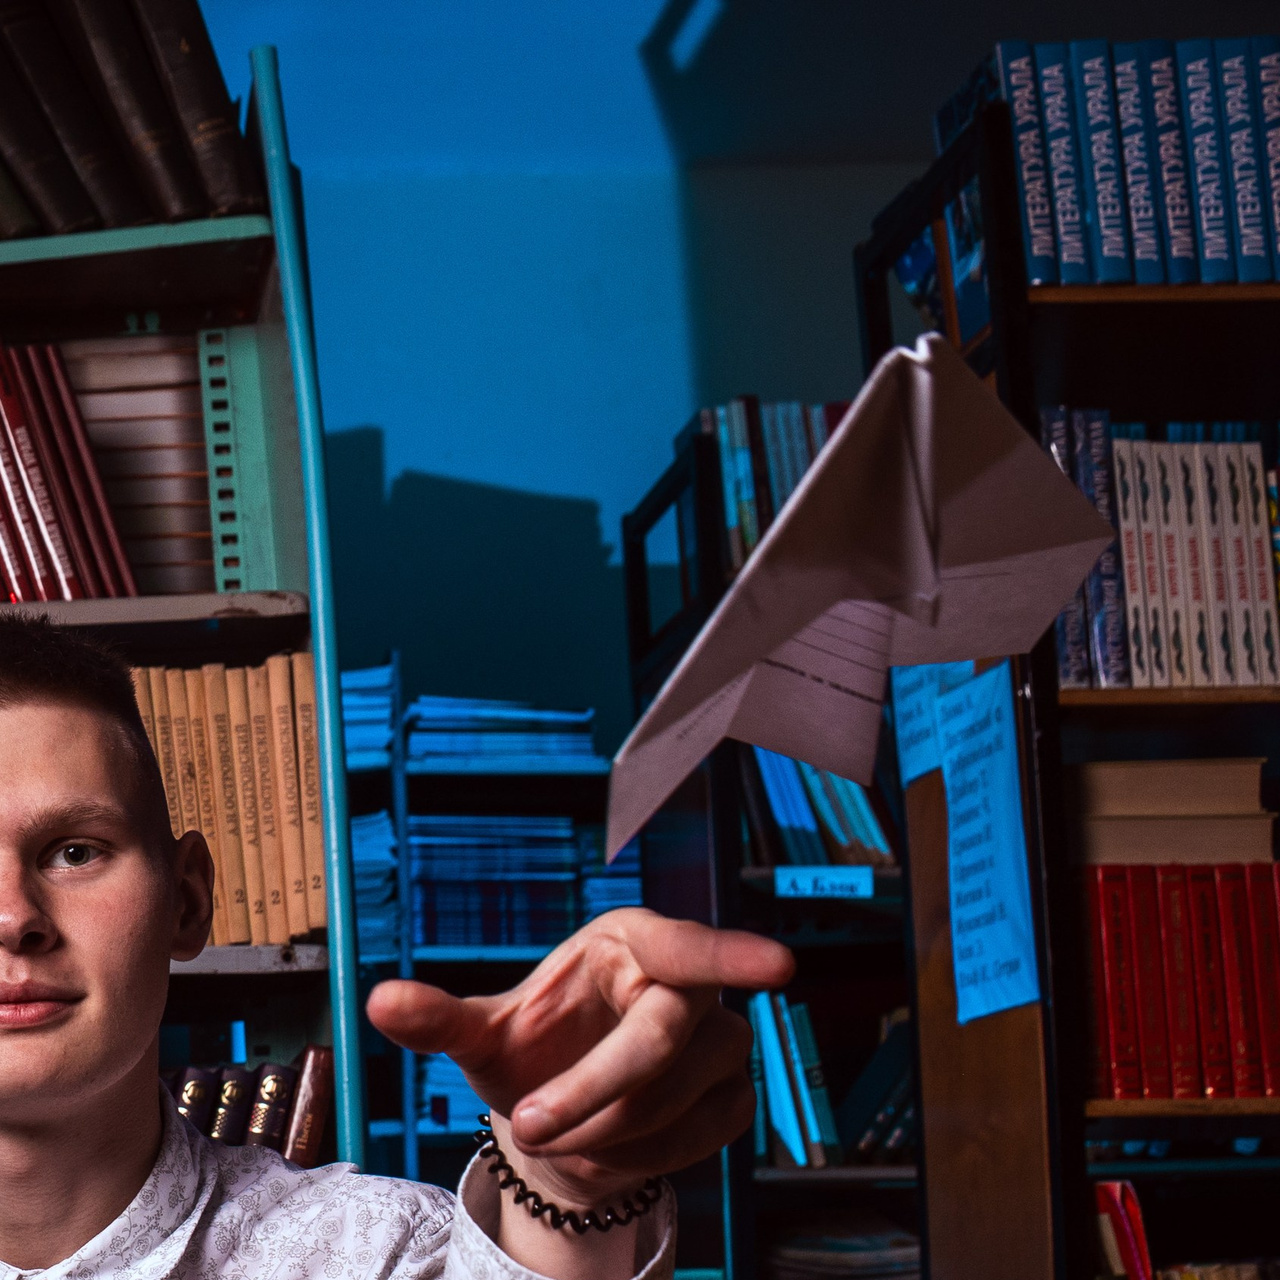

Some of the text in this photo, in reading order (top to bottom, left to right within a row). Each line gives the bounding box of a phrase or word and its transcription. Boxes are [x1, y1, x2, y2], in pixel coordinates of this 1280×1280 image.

[1009, 56, 1054, 258] ЛИТЕРАТУРА УРАЛА
[1042, 63, 1085, 264] ЛИТЕРАТУРА УРАЛА
[1083, 56, 1125, 259] ЛИТЕРАТУРА УРАЛА
[1116, 60, 1158, 262] ЛИТЕРАТУРА УРАЛА
[1150, 56, 1194, 260] ЛИТЕРАТУРА УРАЛА
[1186, 57, 1228, 260] ЛИТЕРАТУРА УРАЛА
[1222, 56, 1265, 257] ЛИТЕРАТУРА УРАЛА
[15, 427, 36, 466] УРАЛА
[27, 467, 56, 523] ИСТОРИЯ
[177, 717, 195, 813] ОСТРОВСКИЙ
[194, 718, 211, 814] ОСТРОВСКИЙ
[216, 714, 234, 810] ОСТРОВСКИЙ
[238, 724, 258, 820] ОСТРОВСКИЙ
[256, 715, 273, 811] ОСТРОВСКИЙ
[277, 705, 296, 801] ОСТРОВСКИЙ
[300, 703, 317, 797] ОСТРОВСКИЙ
[235, 888, 245, 904] 2
[254, 900, 264, 914] 2
[271, 890, 281, 904] 2
[294, 880, 304, 894] 2
[312, 875, 322, 890] 2
